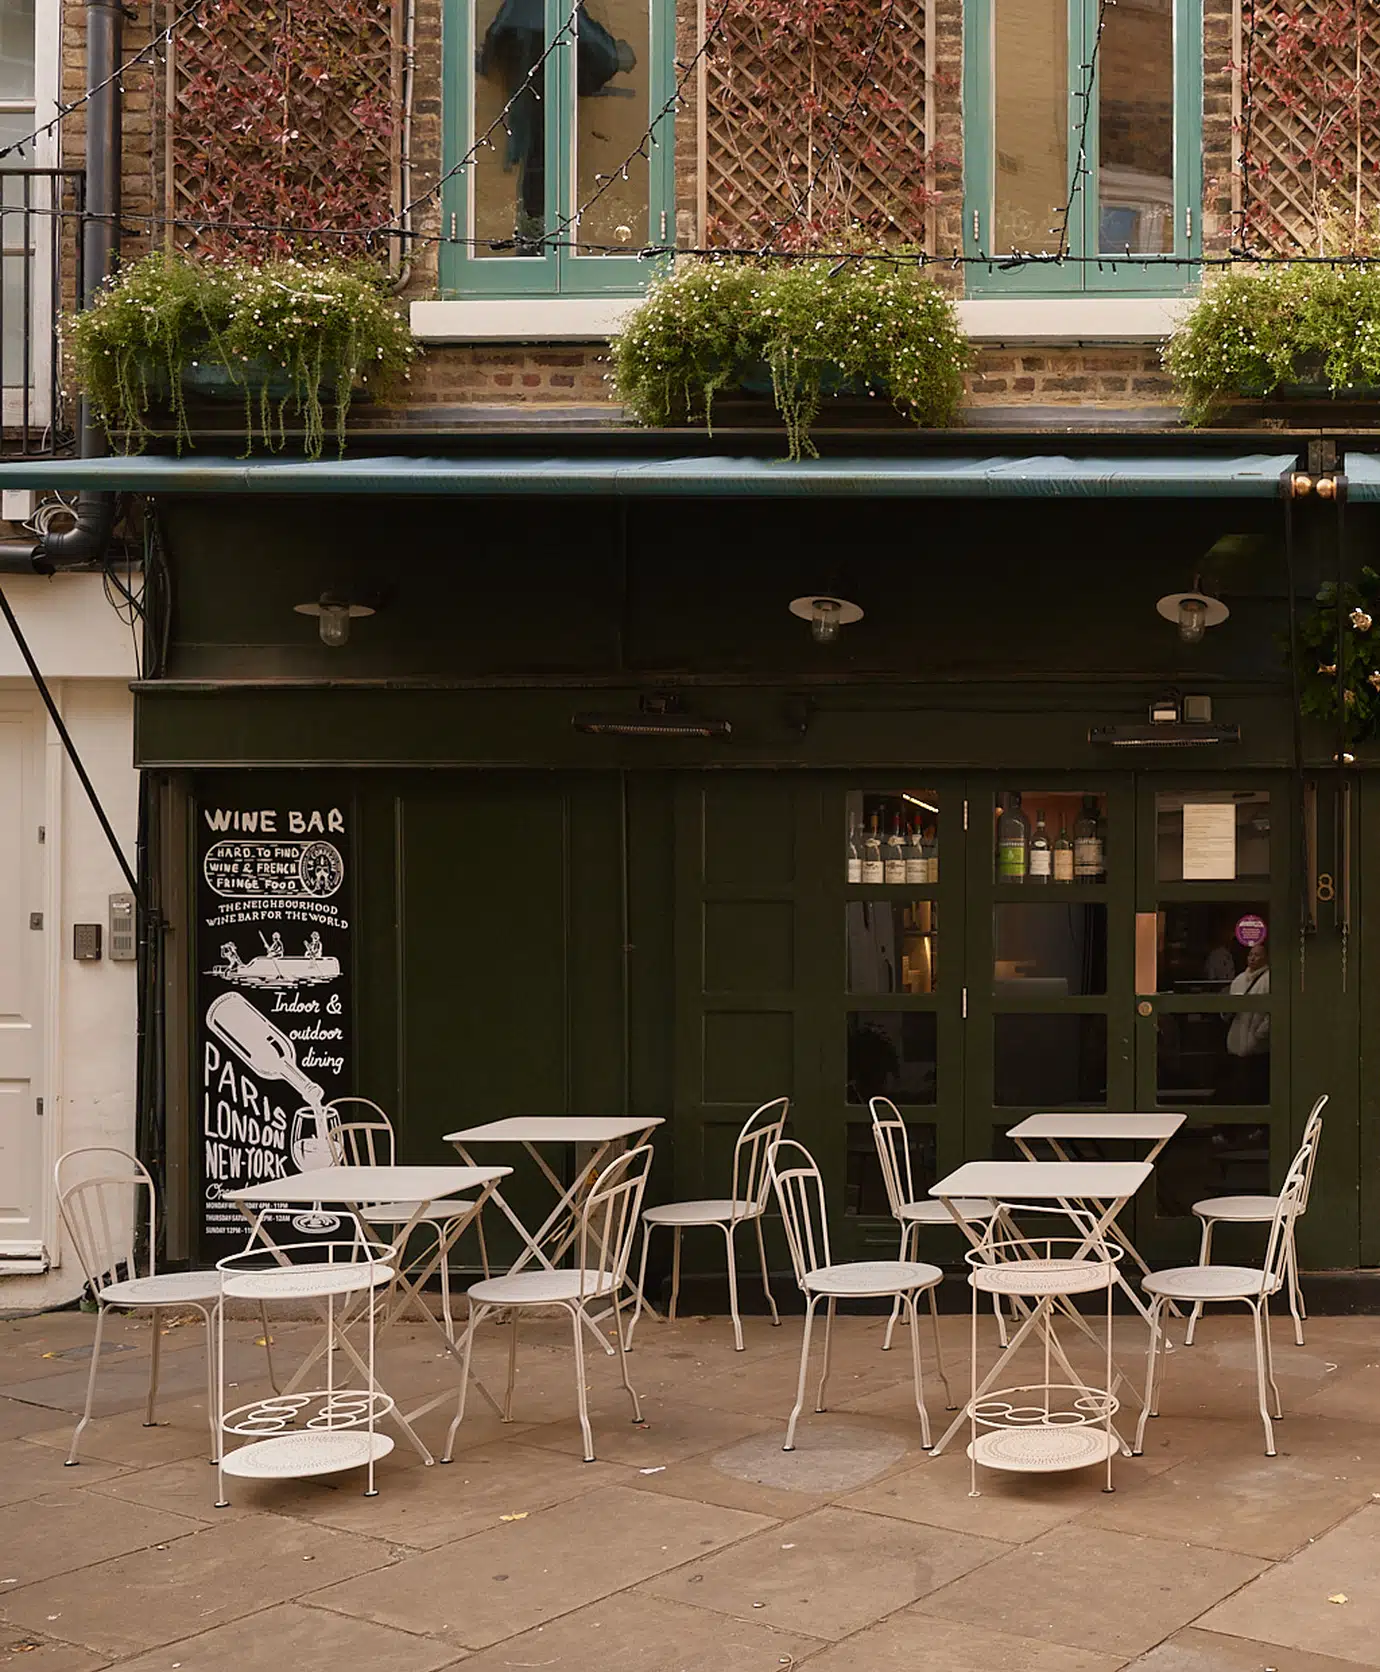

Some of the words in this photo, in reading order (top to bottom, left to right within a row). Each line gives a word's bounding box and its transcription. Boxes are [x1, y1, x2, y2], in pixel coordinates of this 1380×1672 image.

[204, 808, 278, 833] WINE
[288, 807, 345, 834] BAR
[217, 848, 251, 858] HARD
[274, 848, 300, 858] FIND
[209, 863, 239, 873] WINE
[242, 863, 253, 873] &
[257, 863, 297, 874] FRENCH
[216, 878, 259, 889] FRINGE
[1317, 873, 1335, 901] 8
[218, 902, 242, 914] THE
[242, 899, 338, 915] NEIGHBOURHOOD
[205, 914, 237, 927] WINE
[237, 911, 259, 922] BAR
[260, 910, 283, 920] FOR
[285, 911, 308, 921] THE
[309, 913, 349, 929] WORLD
[271, 991, 320, 1013] Indoor
[326, 993, 342, 1014] &
[289, 1019, 344, 1040] outdoor
[301, 1046, 344, 1075] dining
[205, 1041, 287, 1130] PARIS
[205, 1091, 285, 1150] LONDON
[205, 1140, 288, 1181] NEW-YORK
